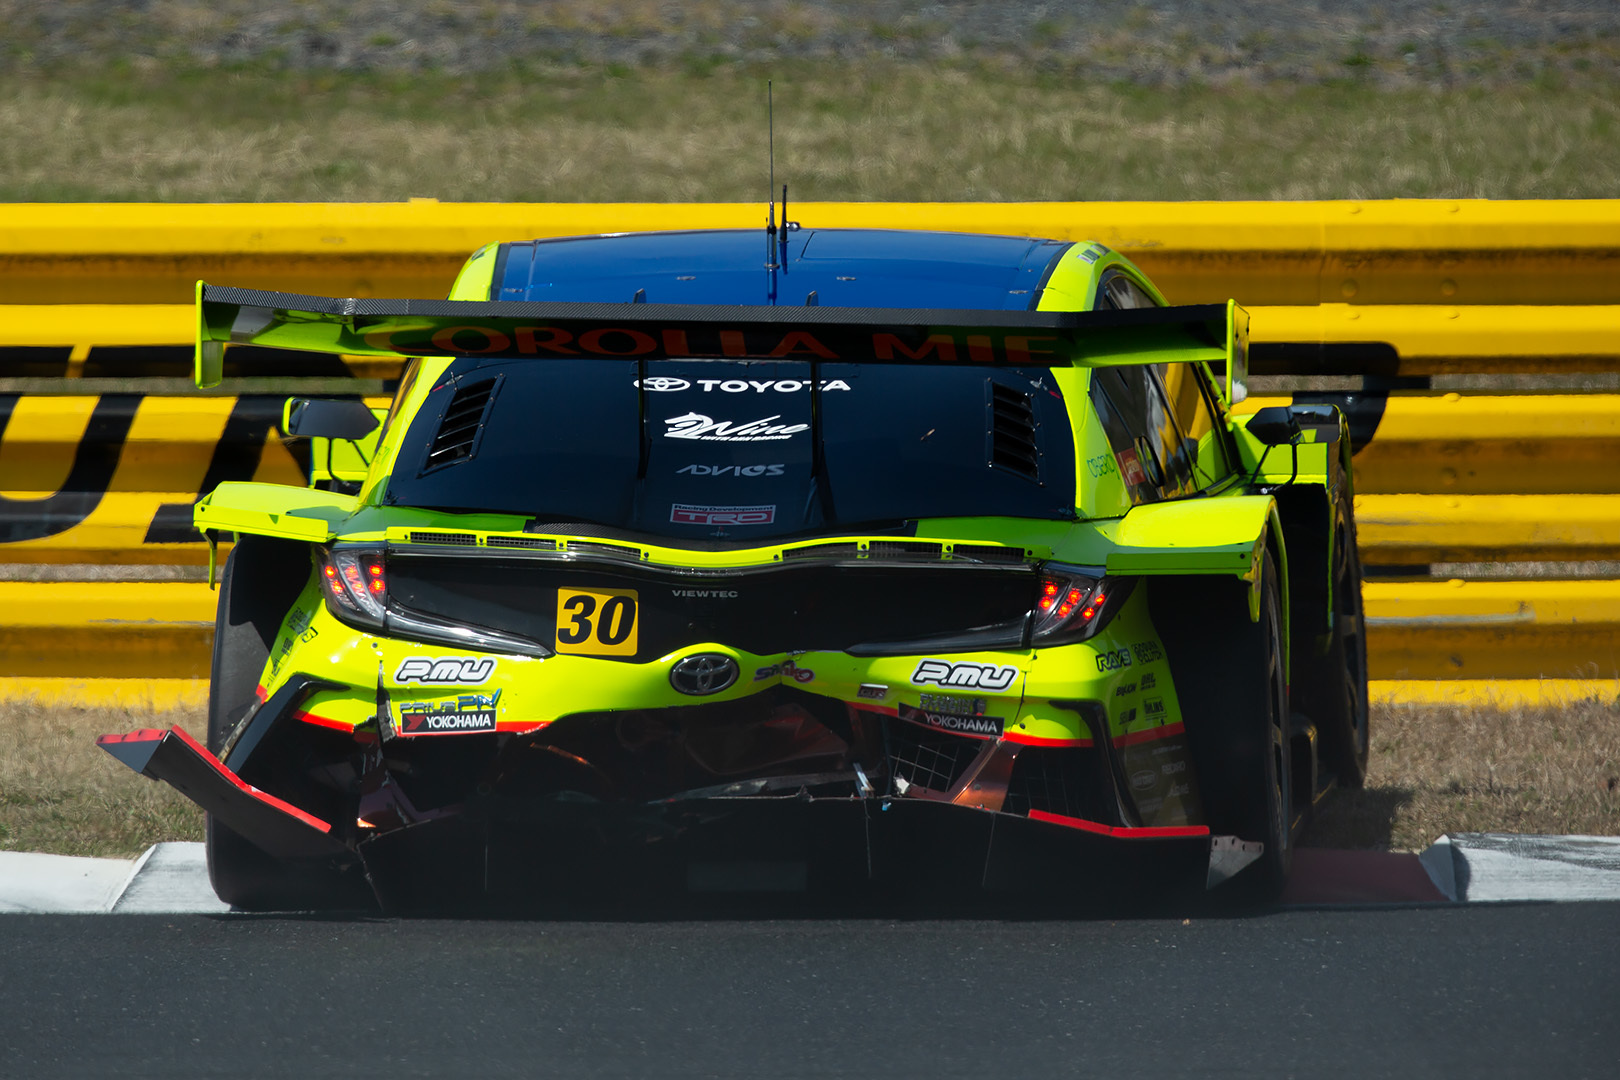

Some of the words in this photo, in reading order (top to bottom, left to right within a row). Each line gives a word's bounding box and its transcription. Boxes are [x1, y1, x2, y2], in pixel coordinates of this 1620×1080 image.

[363, 324, 840, 360] COROLLA
[872, 333, 1060, 363] MIE
[697, 379, 852, 393] TOYOTA
[674, 503, 708, 513] Racing
[708, 505, 774, 514] Development
[677, 511, 769, 525] TRD
[672, 589, 739, 599] VIEWTEC
[557, 594, 637, 646] 30
[1096, 648, 1132, 672] RAYS
[426, 714, 492, 729] YOKOHAMA
[925, 713, 998, 733] YOKOHAMA
